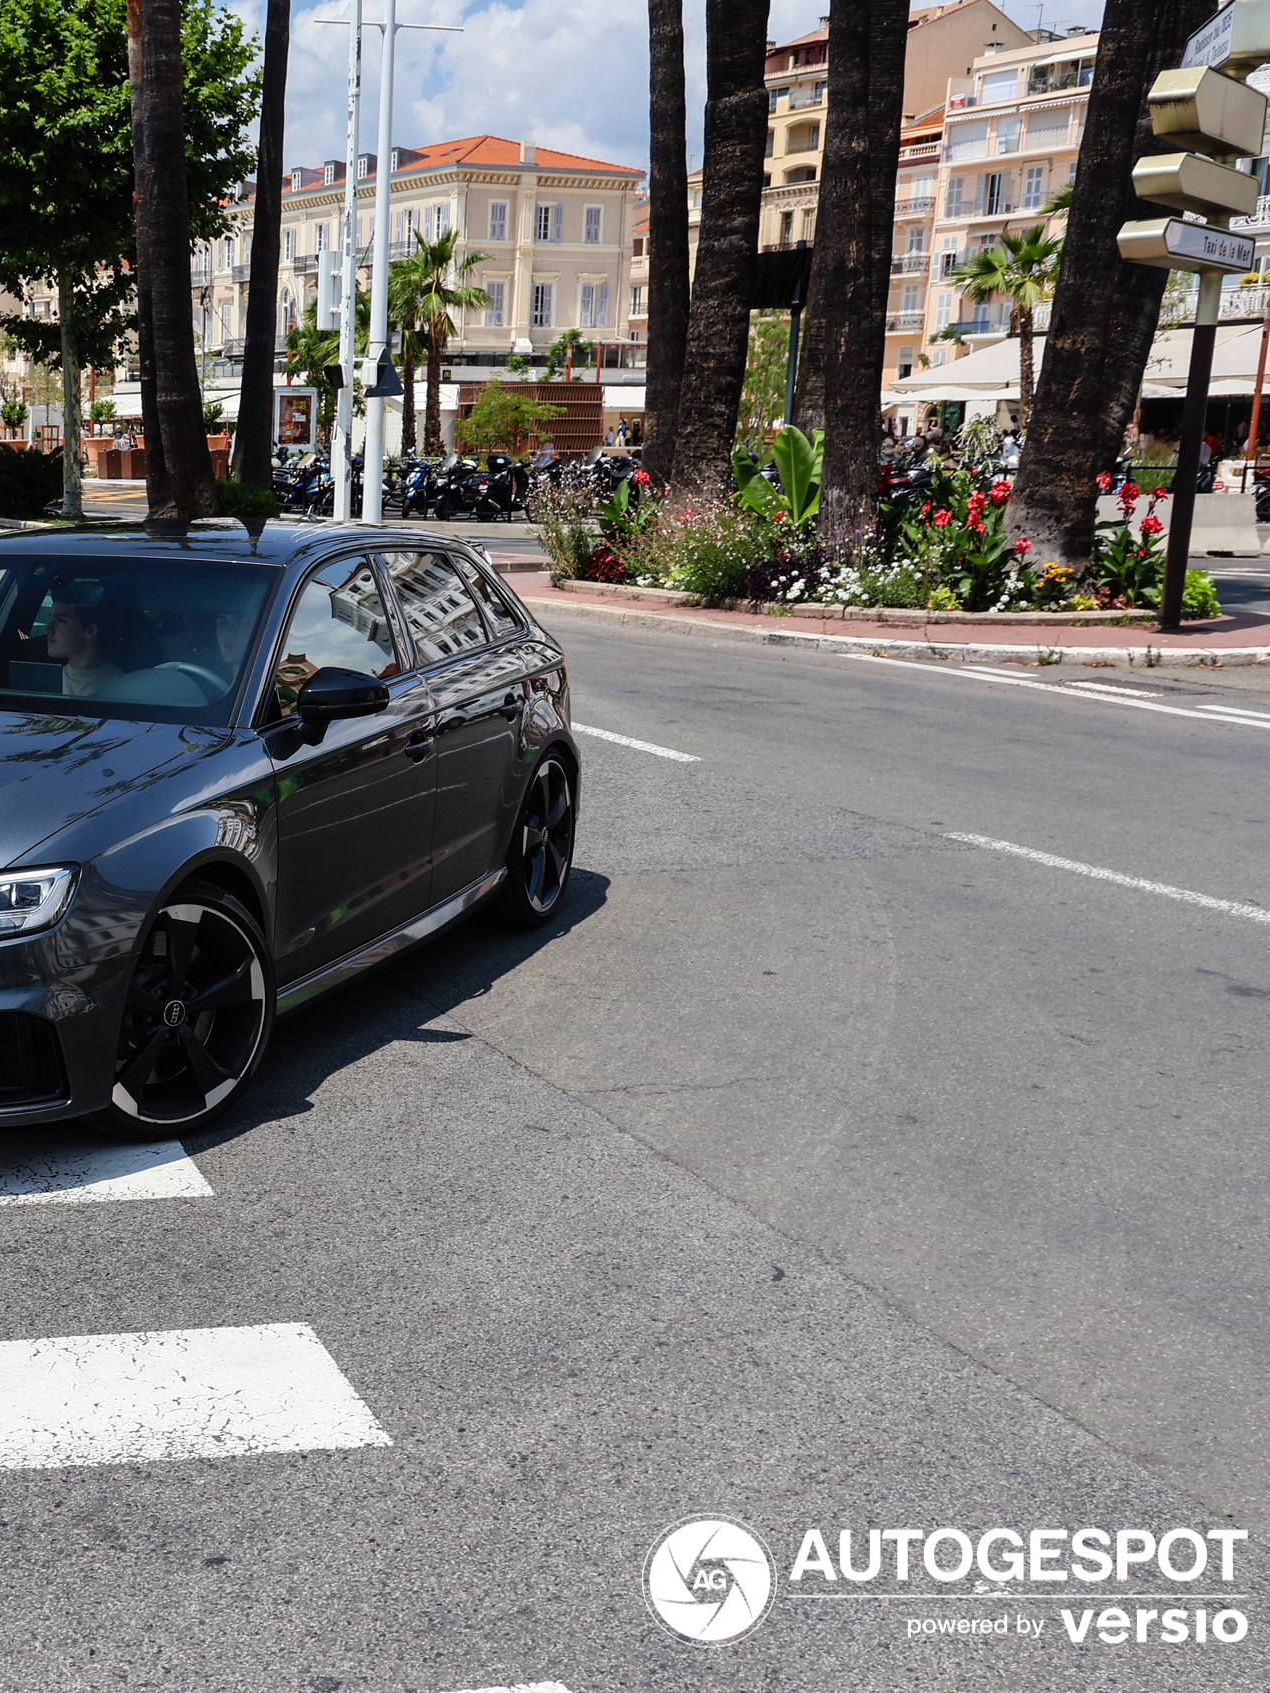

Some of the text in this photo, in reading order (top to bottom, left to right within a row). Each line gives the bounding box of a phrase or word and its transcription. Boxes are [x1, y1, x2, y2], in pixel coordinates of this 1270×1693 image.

[1204, 236, 1250, 262] Taxi de la Mer
